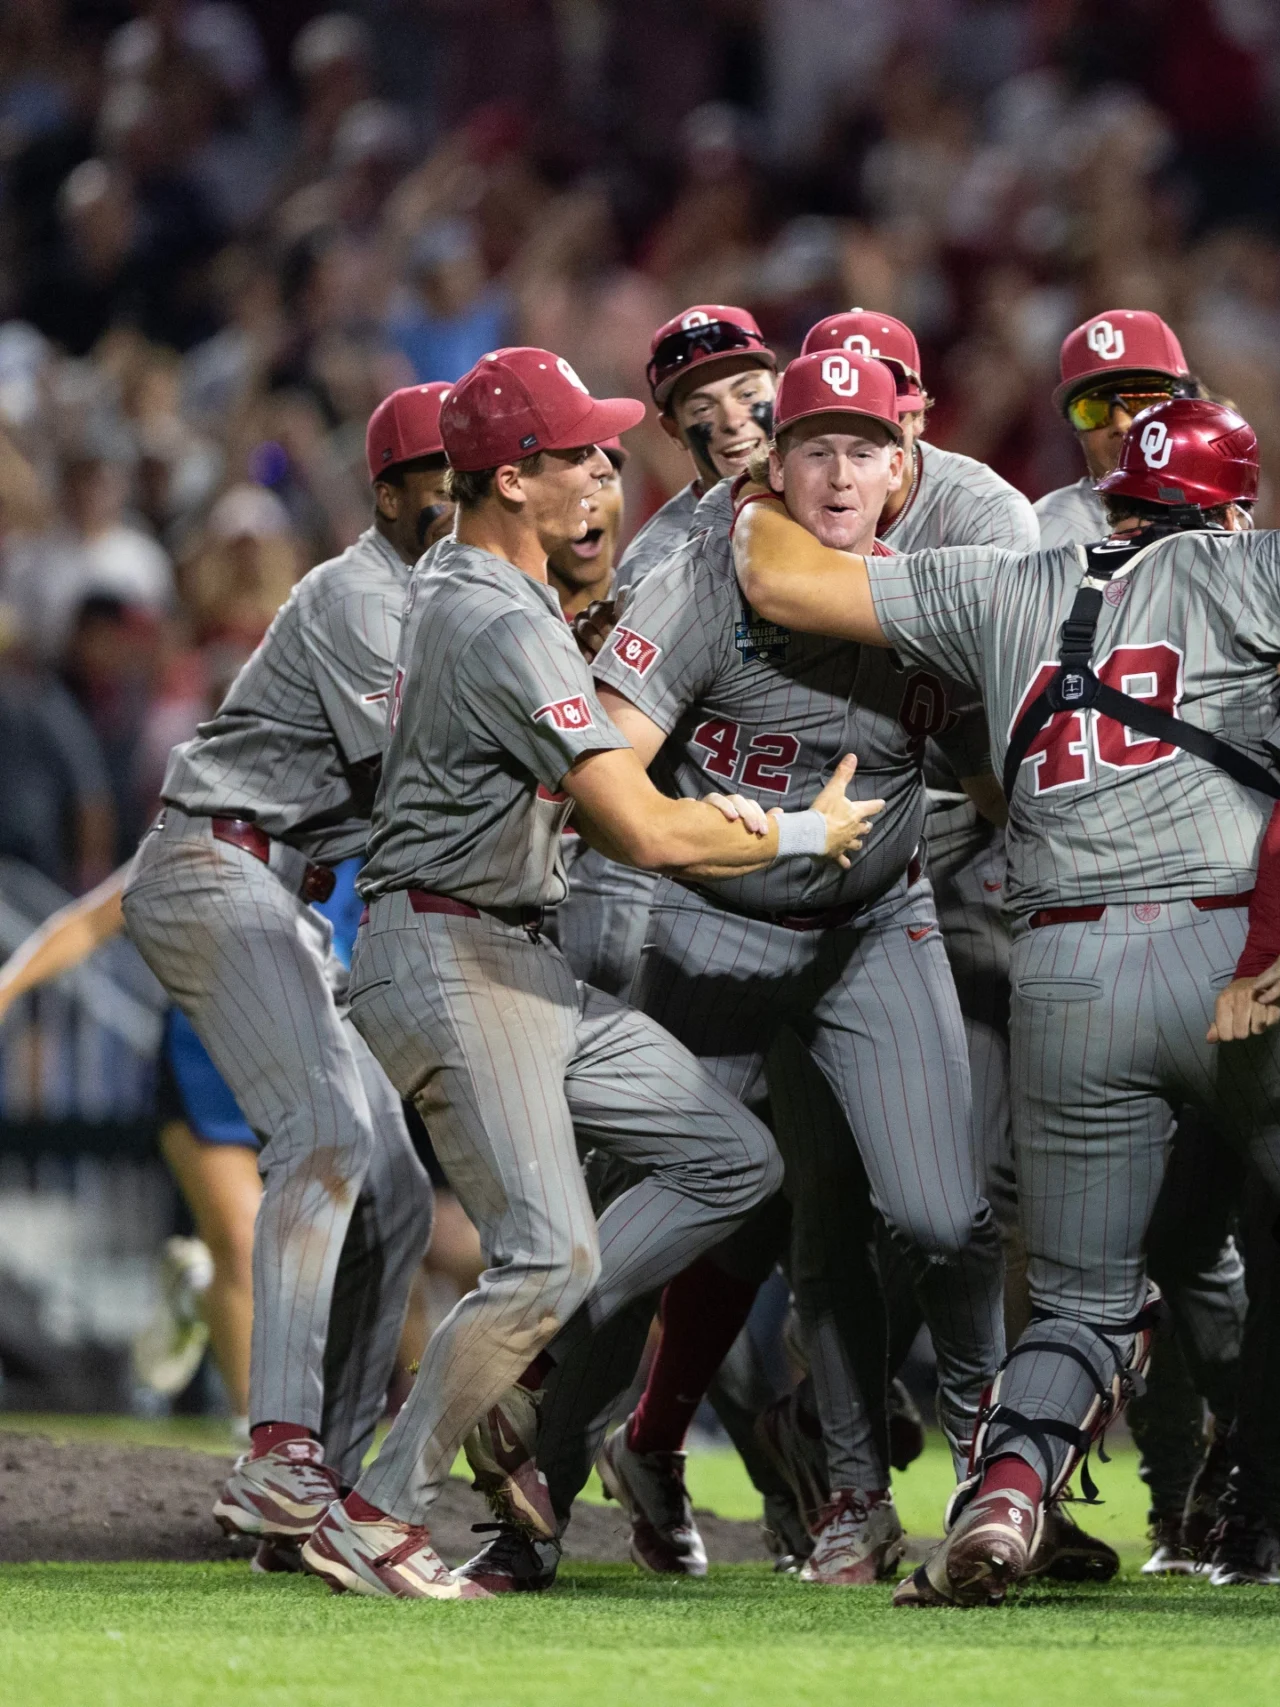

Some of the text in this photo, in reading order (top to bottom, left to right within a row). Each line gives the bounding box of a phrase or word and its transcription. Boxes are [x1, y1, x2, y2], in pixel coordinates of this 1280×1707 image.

[681, 311, 718, 331] O
[843, 334, 880, 357] O
[1087, 320, 1126, 361] OU
[821, 355, 860, 397] OU
[1139, 420, 1174, 470] OU
[626, 639, 643, 660] OU
[563, 703, 582, 724] OU
[1007, 639, 1184, 796] 48
[691, 716, 801, 795] 42
[1008, 1507, 1023, 1525] OU
